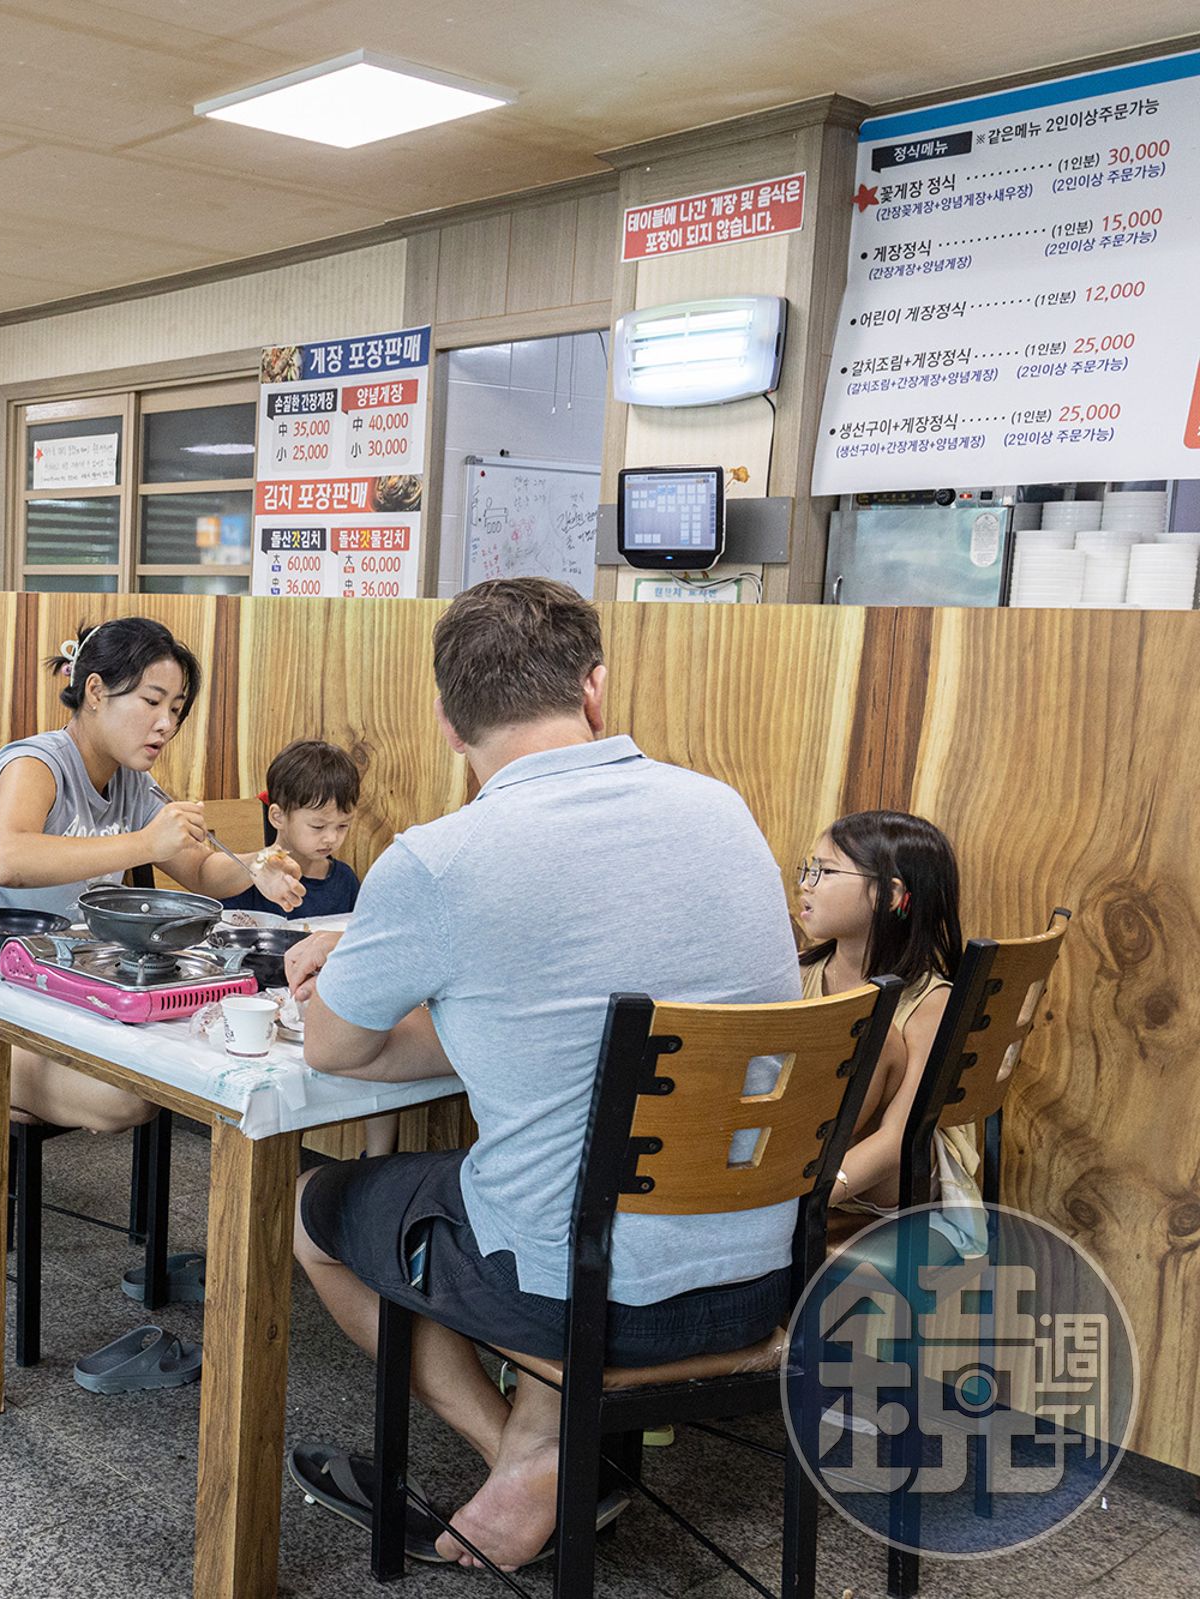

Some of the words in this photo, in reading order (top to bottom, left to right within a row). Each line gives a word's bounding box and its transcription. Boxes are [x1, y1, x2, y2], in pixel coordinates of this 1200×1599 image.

[893, 141, 948, 162] 정식메뉴
[880, 179, 925, 204] 꽃게장
[927, 174, 956, 194] 정식
[1058, 153, 1100, 172] (1인분)
[1108, 140, 1170, 166] 30,000
[1052, 172, 1104, 194] (2인이상
[1107, 162, 1166, 184] 주문가능)
[627, 208, 676, 232] 테이블에
[680, 202, 707, 222] 나간
[711, 194, 738, 216] 게장
[741, 191, 754, 211] 및
[757, 180, 800, 206] 음식은
[645, 231, 682, 253] 포장이
[687, 223, 712, 246] 되지
[717, 211, 775, 240] 않습니다.
[872, 240, 931, 263] 게장정식
[1051, 219, 1093, 238] (1인분)
[1102, 208, 1163, 234] 15,000
[868, 255, 972, 281] (간장게장+양념게장)
[1044, 238, 1096, 257] (2인이상
[1098, 229, 1158, 249] 주문가능)
[859, 309, 901, 328] 어린이
[904, 301, 966, 323] 게장정식
[1034, 290, 1077, 308] (1인분)
[1085, 281, 1145, 304] 12,000
[310, 345, 343, 373] 게장
[349, 334, 421, 368] 포장판매
[851, 348, 972, 375] 갈치조림+게장정식
[1024, 341, 1067, 358] (1인분)
[1073, 333, 1135, 355] 25,000
[1016, 362, 1068, 380] (2인이상
[1070, 356, 1129, 375] 주문가능)
[301, 391, 334, 412] 간장게장
[357, 383, 403, 407] 양념게장
[293, 420, 330, 437] 35,000
[368, 412, 408, 432] 40,000
[839, 413, 958, 440] 생선구이+게장정식
[1011, 408, 1052, 425] (1인분)
[1058, 403, 1121, 426] 25,000
[368, 438, 408, 458] 30,000
[1003, 431, 1054, 448] (2인이상
[1056, 426, 1115, 443] 주문가능)
[293, 444, 328, 460] 25,000
[264, 485, 292, 510] 김치
[297, 482, 368, 510] 포장판매
[271, 530, 321, 548] 돌산갓김치
[288, 556, 320, 573] 60,000
[361, 556, 401, 574] 60,000
[286, 579, 320, 595] 36,000
[361, 581, 399, 597] 36,000
